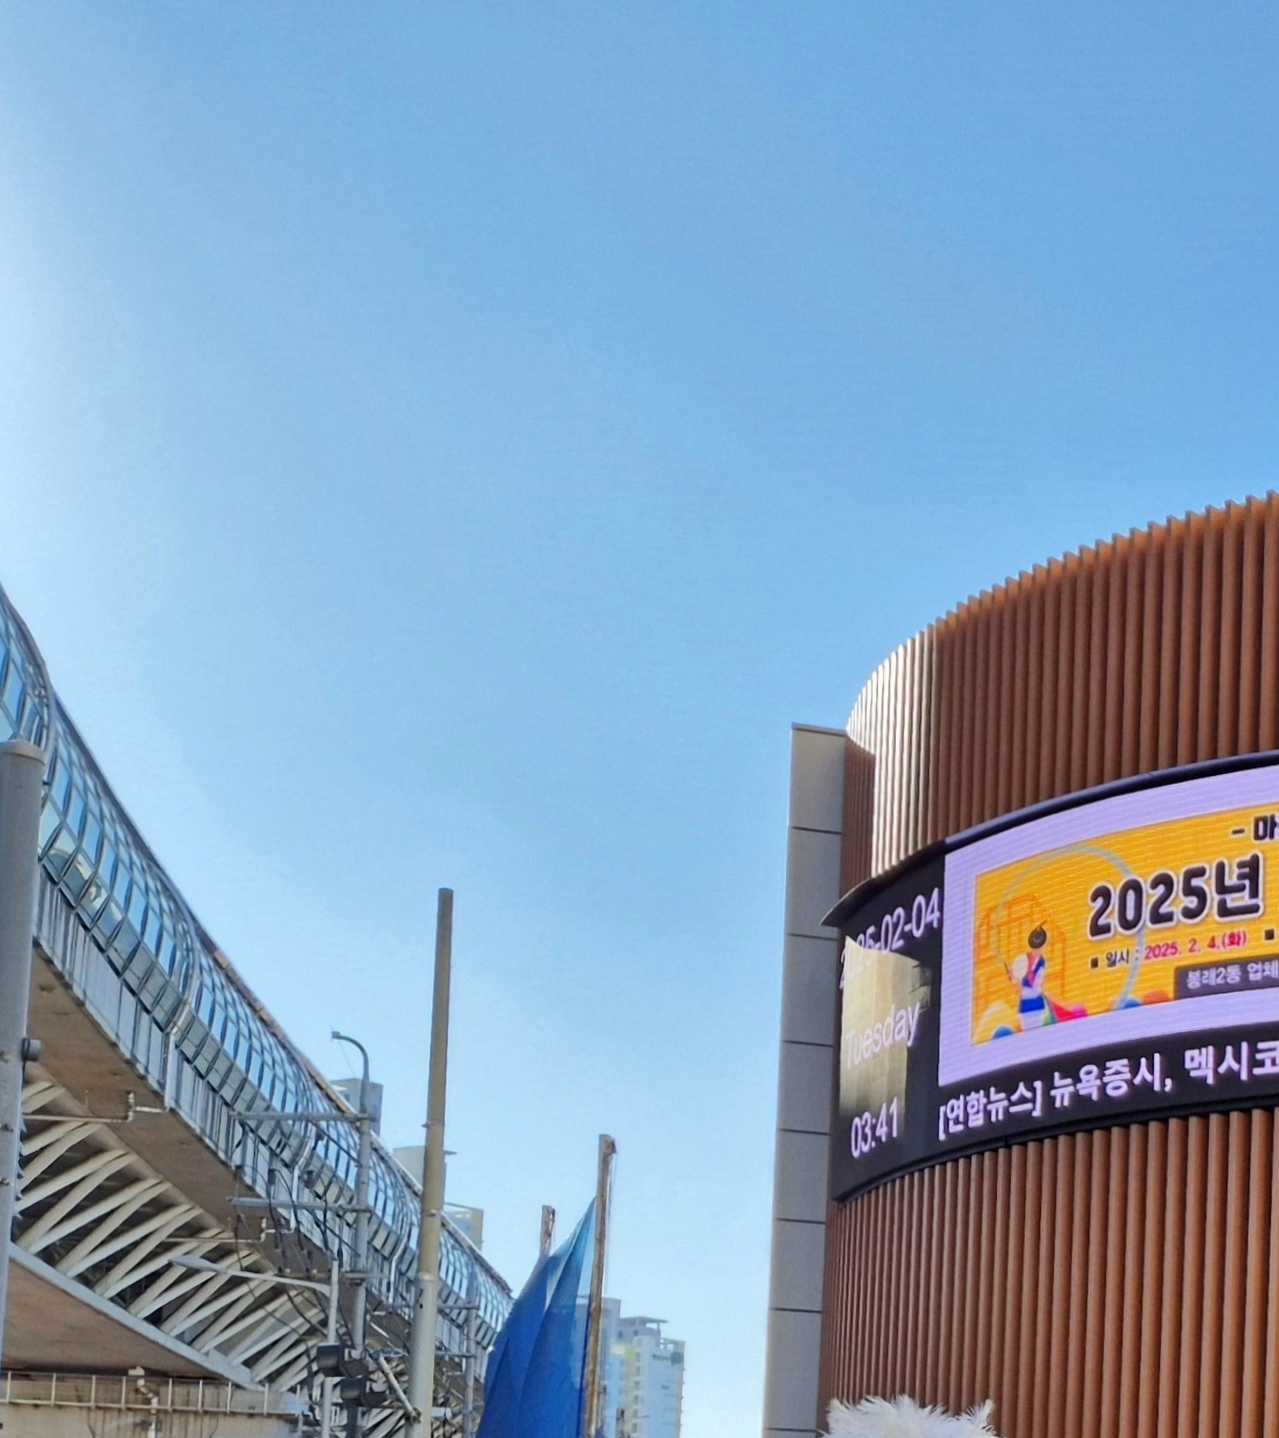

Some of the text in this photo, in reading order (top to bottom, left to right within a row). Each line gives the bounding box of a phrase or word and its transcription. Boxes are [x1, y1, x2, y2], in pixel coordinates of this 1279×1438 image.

[1088, 853, 1262, 938] 2025년
[1105, 949, 1131, 968] 일시
[1144, 941, 1183, 961] 2025.
[1186, 965, 1242, 990] 봉래2동
[1247, 960, 1279, 981] 업체
[846, 1002, 921, 1069] Tuesday
[850, 1096, 898, 1159] 03:41
[938, 1080, 1042, 1141] [연합뉴스]
[1050, 1052, 1172, 1108] 뉴욕증시,
